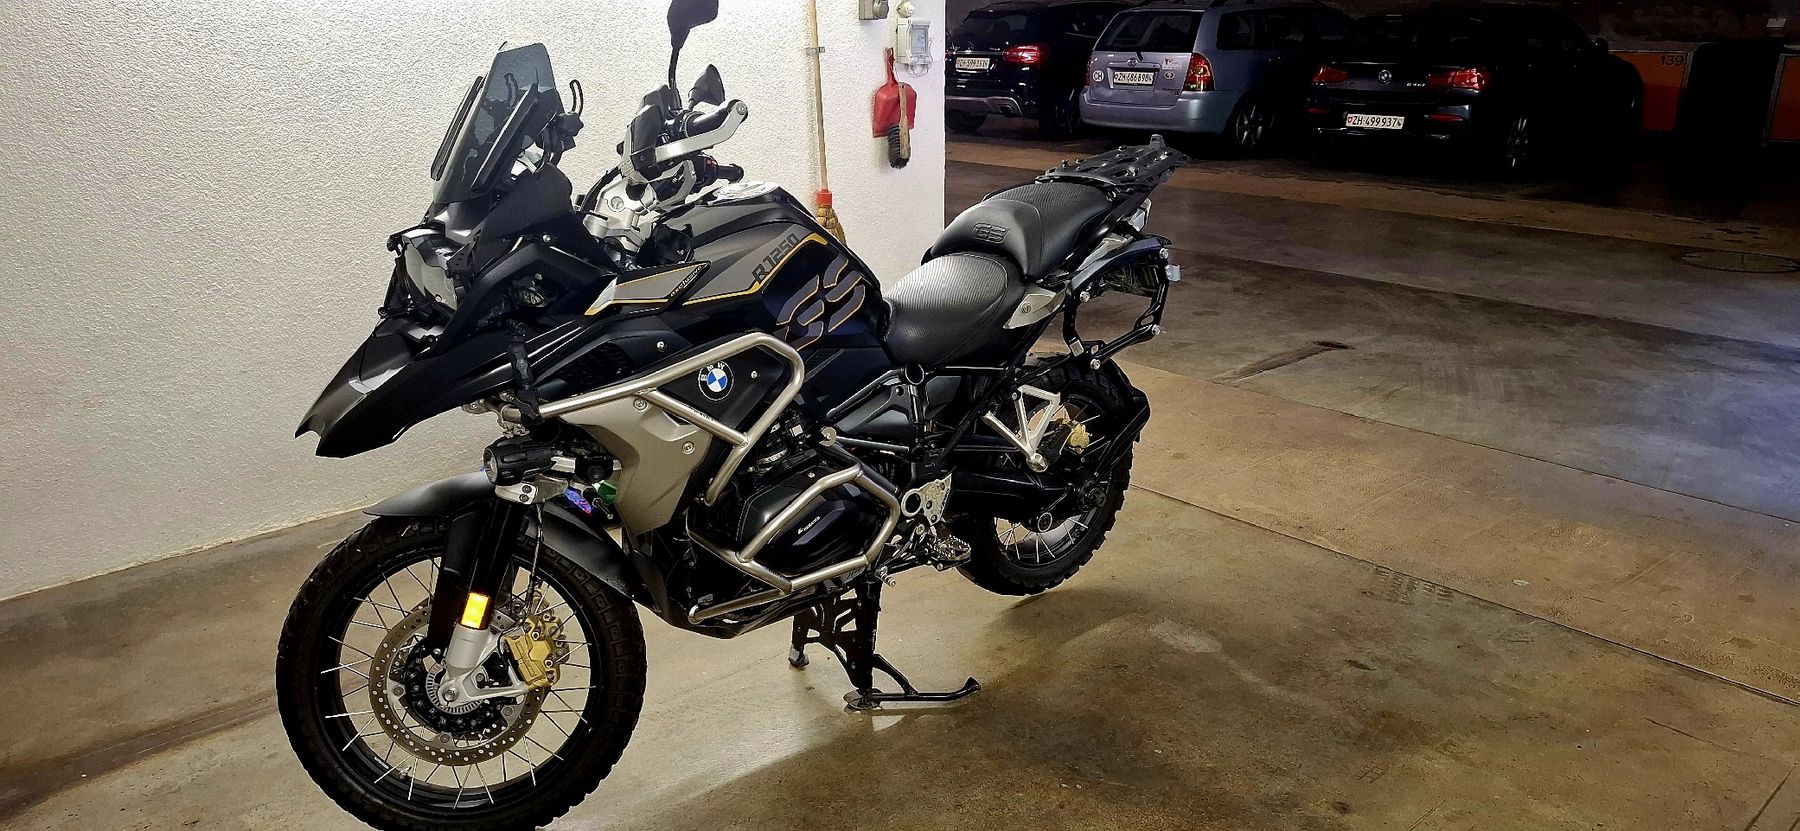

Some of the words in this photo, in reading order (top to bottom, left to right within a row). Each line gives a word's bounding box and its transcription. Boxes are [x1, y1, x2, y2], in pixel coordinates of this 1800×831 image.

[1660, 55, 1684, 66] 139
[1094, 71, 1104, 80] CH
[972, 222, 1009, 243] GS
[670, 265, 703, 297] exclusive
[775, 253, 867, 353] GS
[700, 362, 726, 382] BMW
